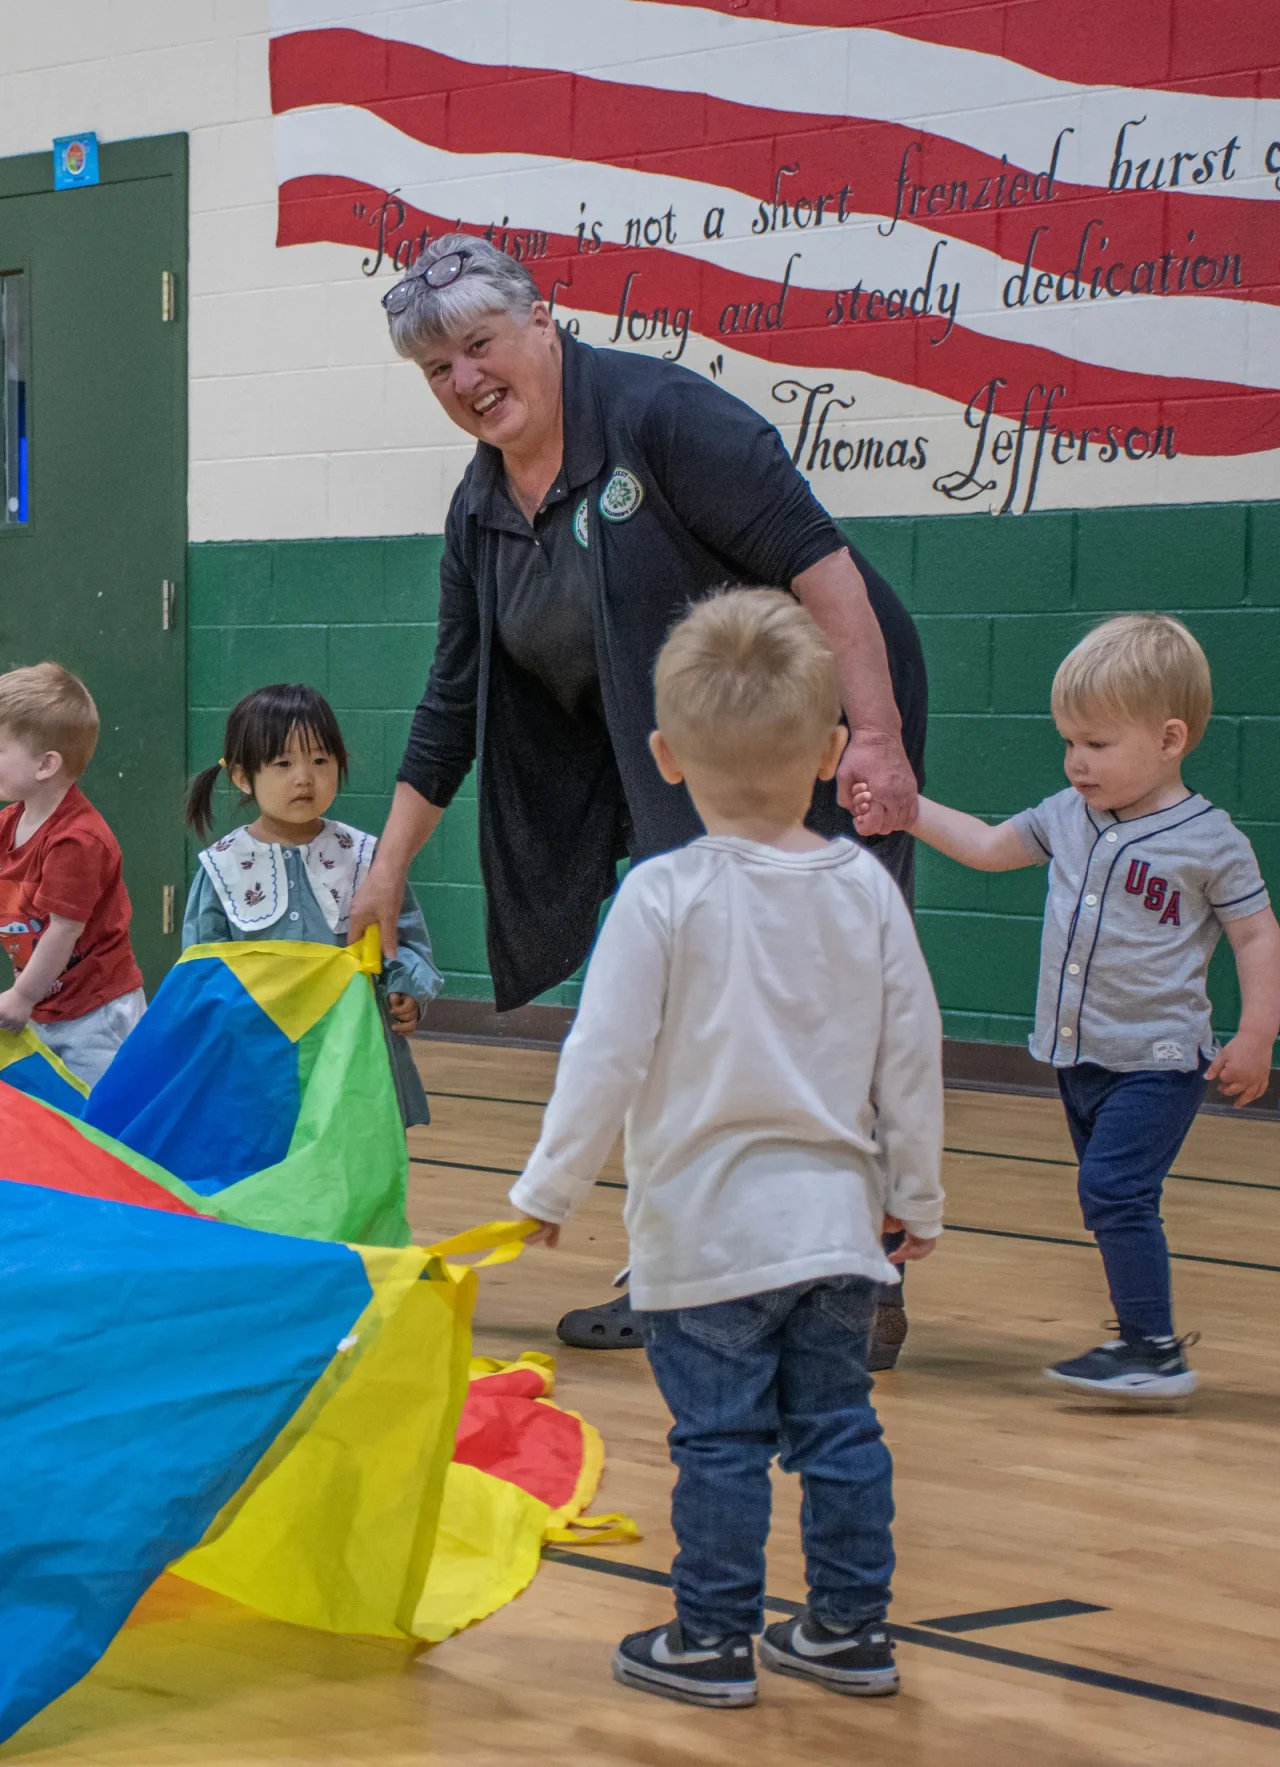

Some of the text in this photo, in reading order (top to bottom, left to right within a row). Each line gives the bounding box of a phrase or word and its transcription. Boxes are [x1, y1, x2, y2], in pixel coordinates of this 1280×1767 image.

[576, 202, 602, 255] is
[624, 203, 678, 248] not
[703, 206, 725, 240] a
[751, 162, 854, 235] short
[877, 127, 1075, 237] frenzied
[1107, 115, 1242, 193] burst
[609, 271, 692, 362] long
[720, 253, 803, 330] and
[826, 239, 961, 348] steady
[1003, 219, 1244, 310] dedication
[771, 377, 1179, 517] Thomas Jefferson
[1124, 858, 1181, 927] USA
